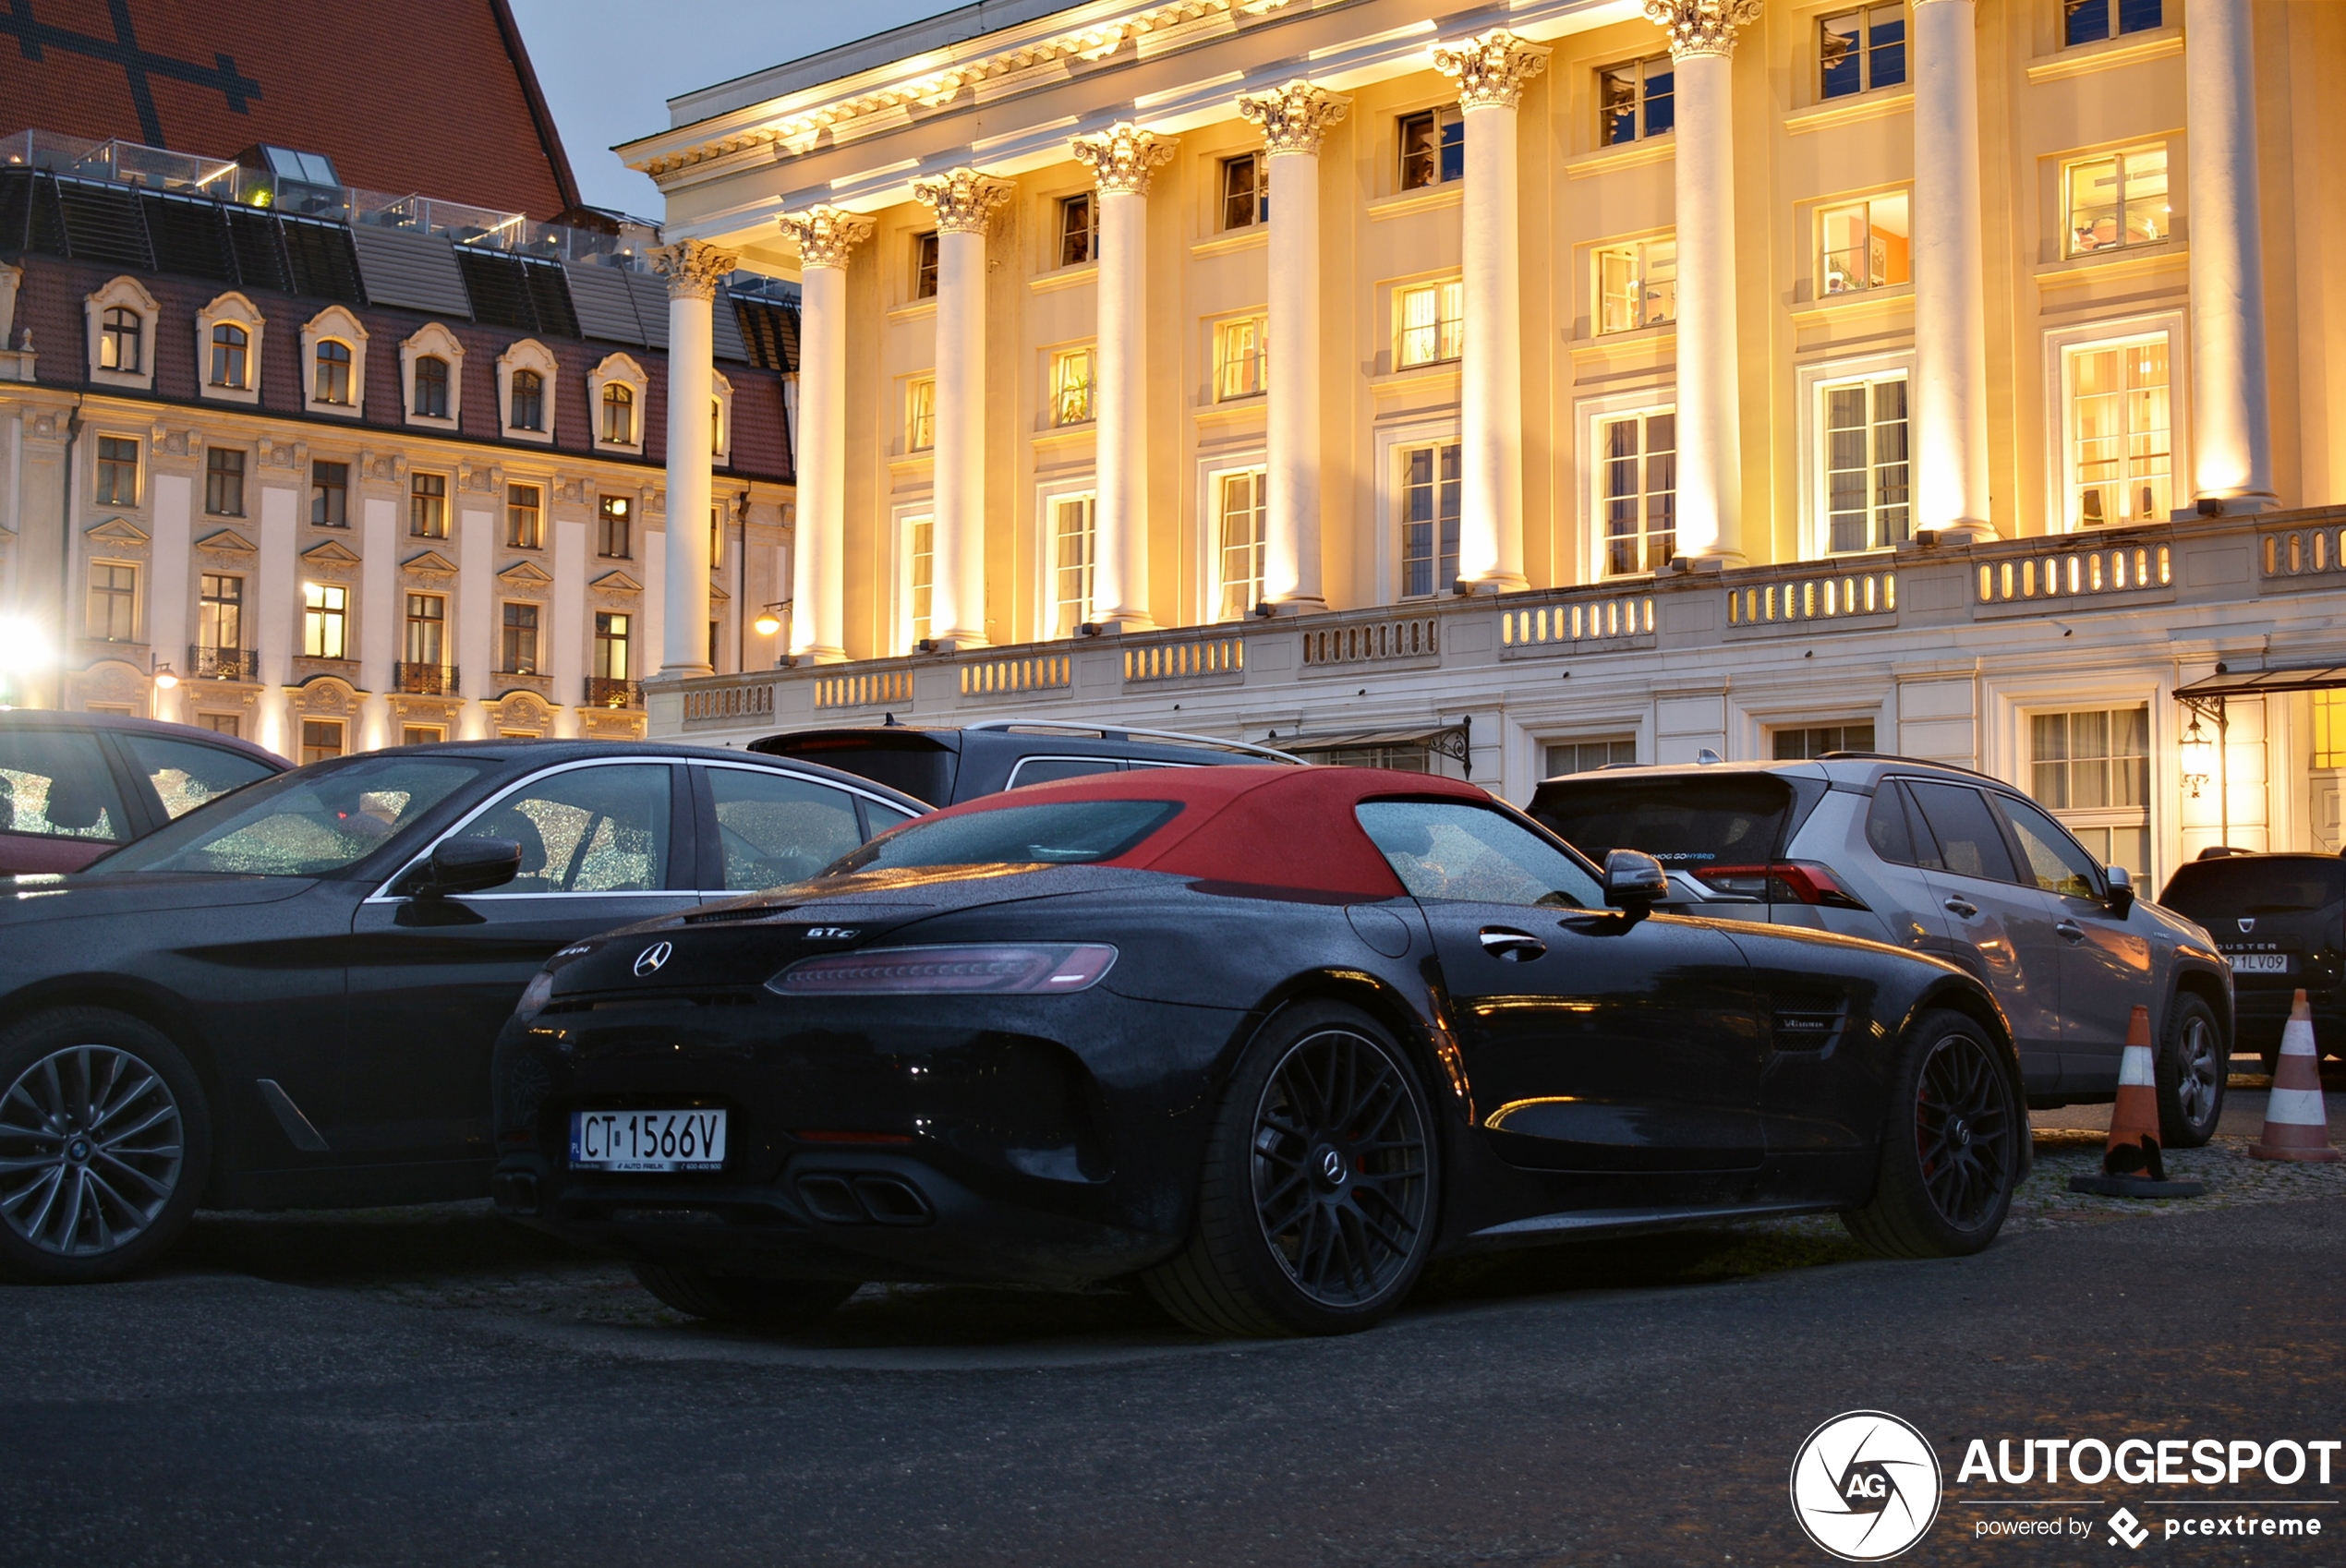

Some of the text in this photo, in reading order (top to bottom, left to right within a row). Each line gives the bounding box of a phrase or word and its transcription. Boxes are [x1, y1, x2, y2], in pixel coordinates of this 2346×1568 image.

[2242, 956, 2284, 969] 1LV09
[586, 1115, 718, 1158] CT 1566V
[571, 1142, 580, 1154] PL
